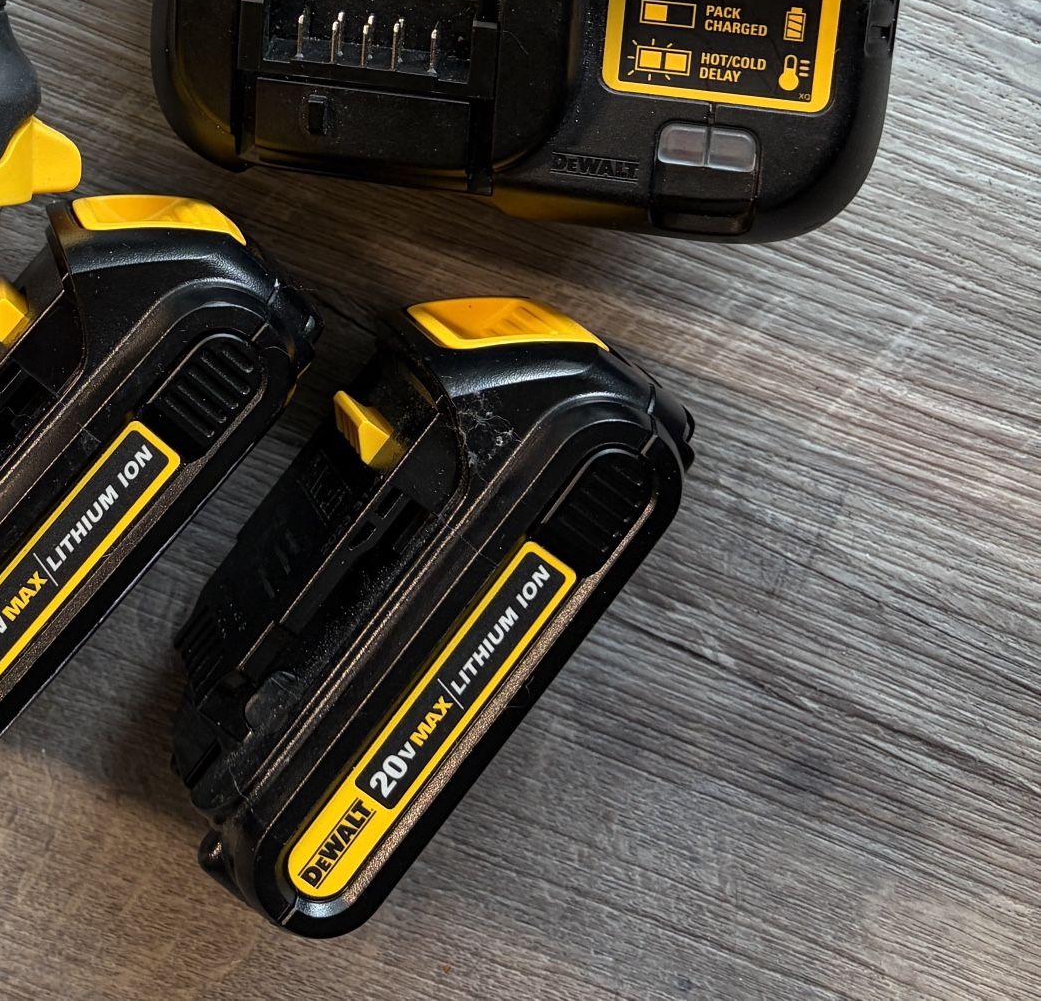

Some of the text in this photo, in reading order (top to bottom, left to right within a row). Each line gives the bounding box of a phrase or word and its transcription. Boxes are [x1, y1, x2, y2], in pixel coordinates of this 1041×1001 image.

[705, 5, 741, 20] PACK
[704, 19, 768, 37] CHARGED
[700, 52, 767, 71] HOT/COLD
[699, 66, 742, 83] DELAY
[1, 570, 49, 622] MAX
[46, 484, 119, 572] LITHIUM
[117, 444, 153, 488] ION
[409, 695, 454, 747] MAX
[450, 606, 520, 695] LITHIUM
[515, 564, 551, 609] ION
